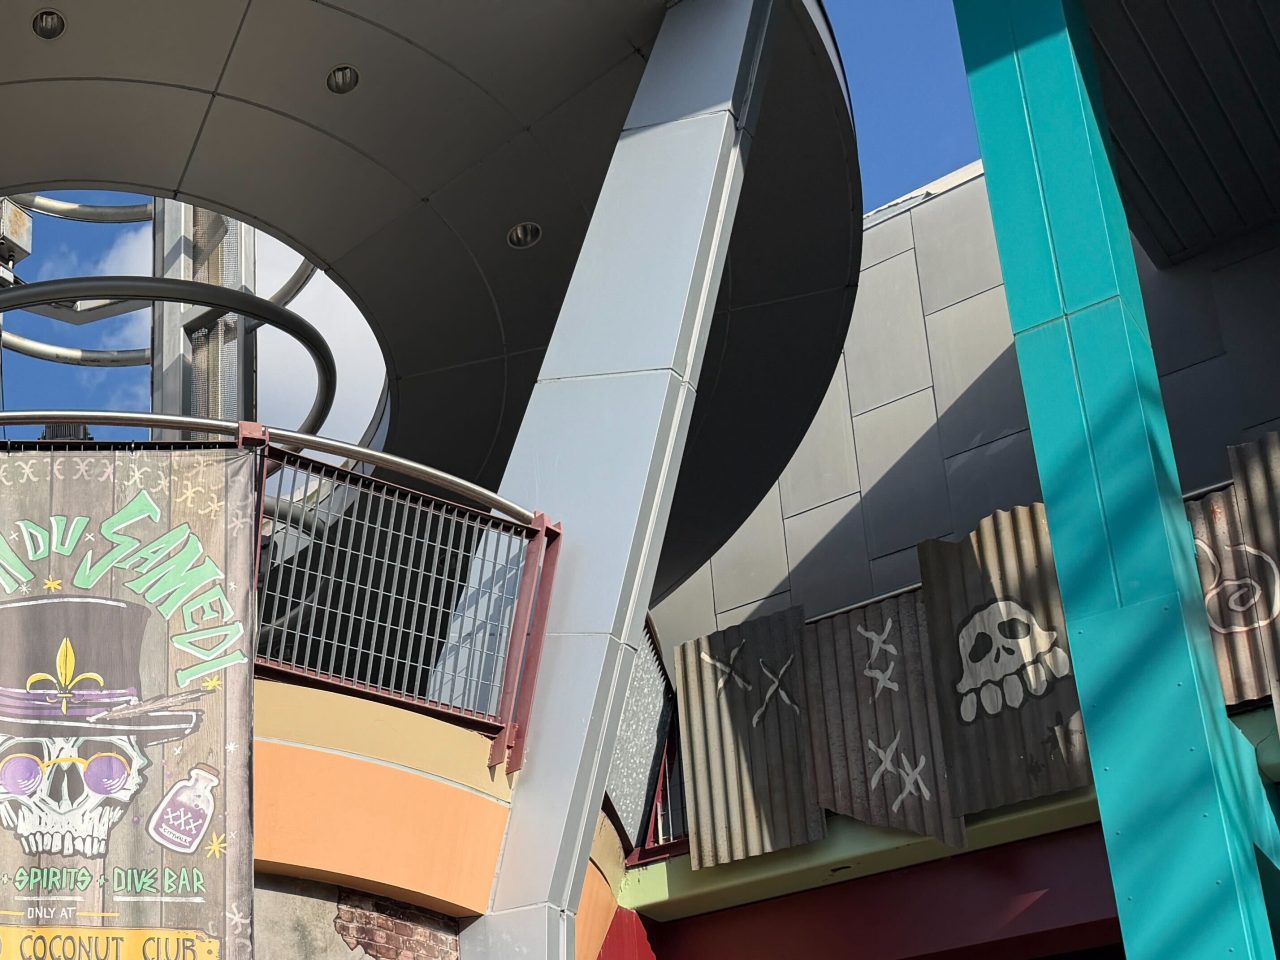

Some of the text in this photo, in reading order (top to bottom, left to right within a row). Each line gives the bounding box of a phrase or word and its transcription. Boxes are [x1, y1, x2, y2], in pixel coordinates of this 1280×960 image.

[15, 514, 91, 561] DU
[72, 489, 248, 688] SAMEDI
[13, 866, 93, 892] SPIRITS
[113, 866, 160, 893] DIVE
[162, 866, 207, 893] BAR
[27, 906, 76, 920] ONLY AT
